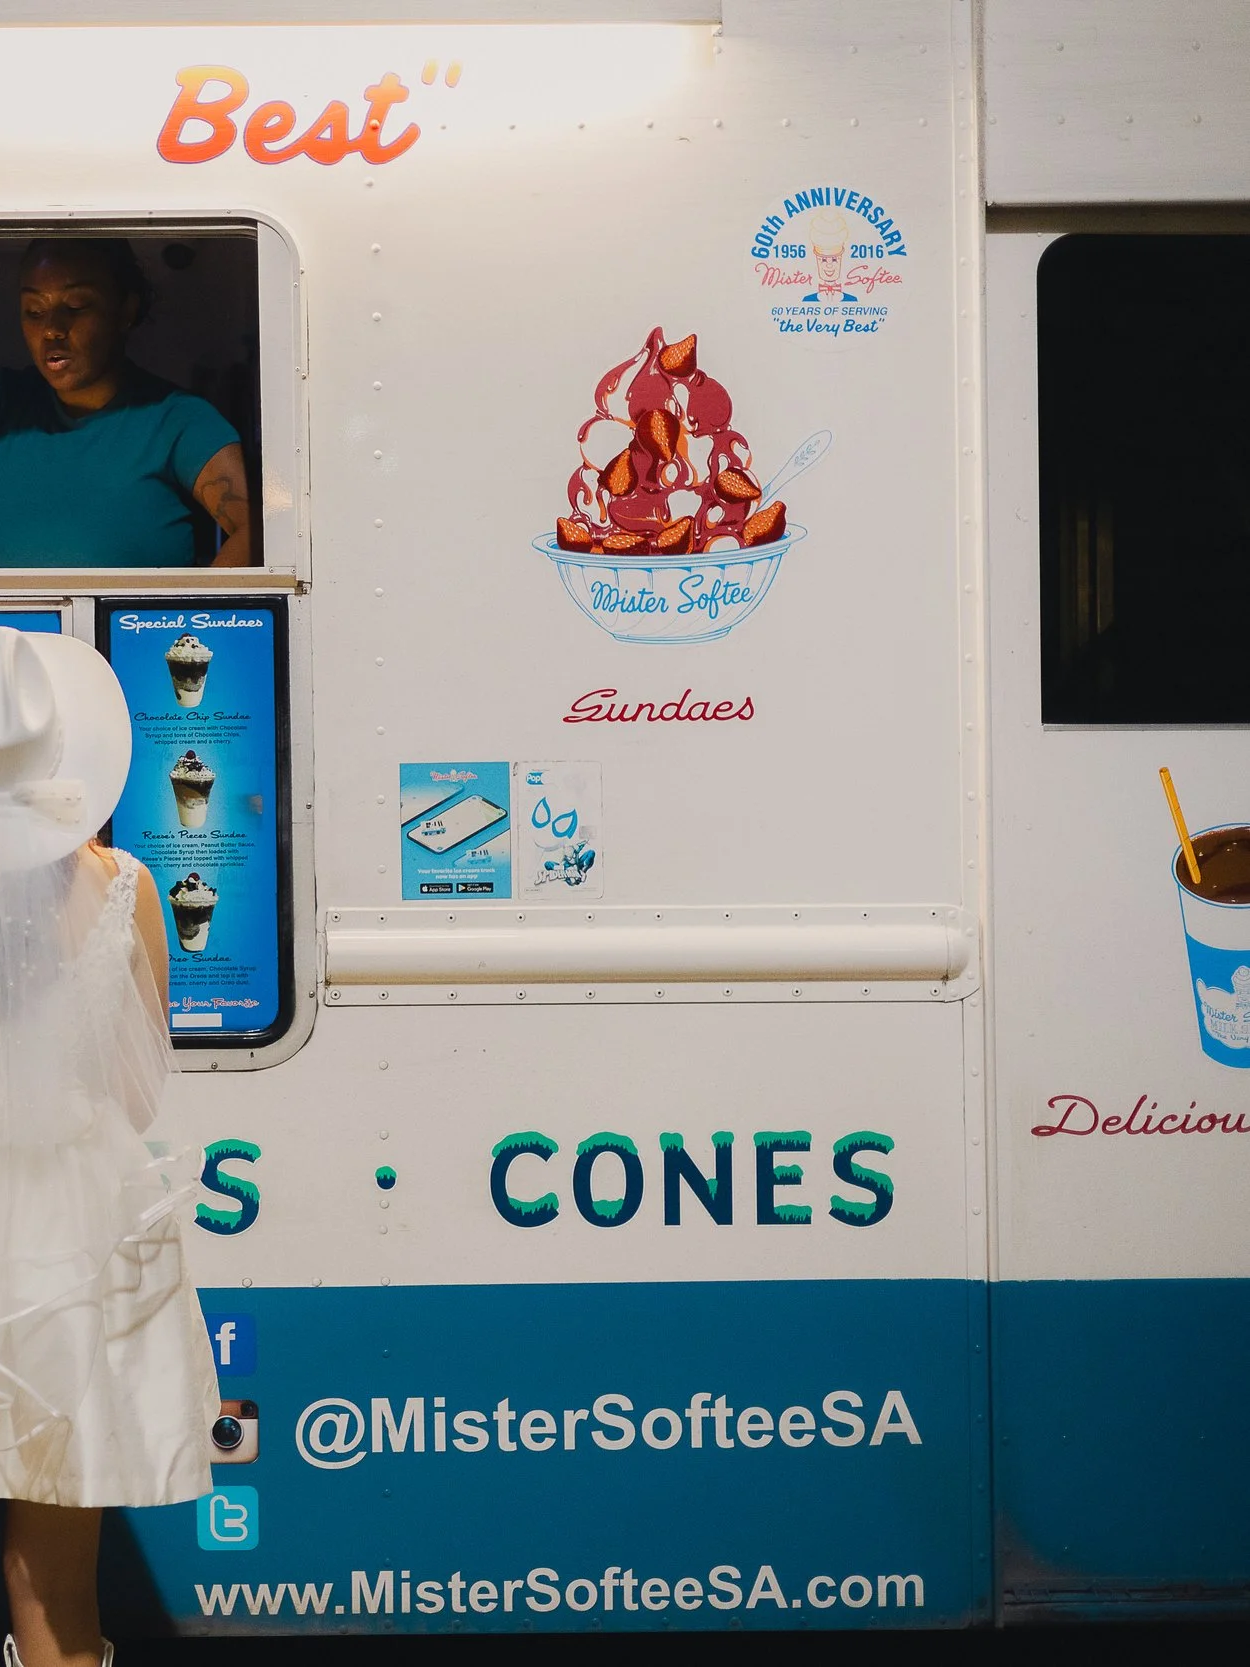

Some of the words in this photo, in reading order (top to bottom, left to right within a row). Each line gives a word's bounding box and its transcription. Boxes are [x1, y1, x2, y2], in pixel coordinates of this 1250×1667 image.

[156, 58, 463, 165] Best"
[750, 214, 785, 259] 60th
[783, 187, 907, 257] ANNIVERSARY
[773, 244, 806, 259] 1956
[850, 244, 884, 259] 2016
[754, 262, 812, 288] Mister
[844, 265, 902, 294] Softee
[771, 306, 784, 316] 60
[786, 306, 821, 316] YEARS
[823, 306, 839, 316] OF
[841, 306, 888, 316] SERVING
[773, 317, 803, 333] "the
[806, 318, 840, 337] Very
[843, 317, 885, 333] Best"
[590, 580, 669, 614] Mister
[678, 574, 755, 619] Softee
[118, 614, 186, 634] Special
[191, 613, 264, 630] Sundaes
[134, 712, 183, 721] Chocolate
[186, 711, 210, 722] Chip
[213, 711, 251, 720] Sundae
[562, 688, 756, 723] Sundaes
[142, 830, 175, 840] Reese's
[178, 830, 207, 839] Pieces
[210, 830, 247, 839] Sundae
[191, 953, 232, 962] Sundae
[182, 996, 211, 1012] Your
[211, 997, 260, 1010] Favorite
[1203, 1001, 1239, 1022] Mister
[1030, 1094, 1250, 1137] Deliciou
[488, 1130, 896, 1236] CONES
[295, 1388, 923, 1470] @MisterSofteeSA
[195, 1564, 925, 1618] www.MisterSofteeSA.com
